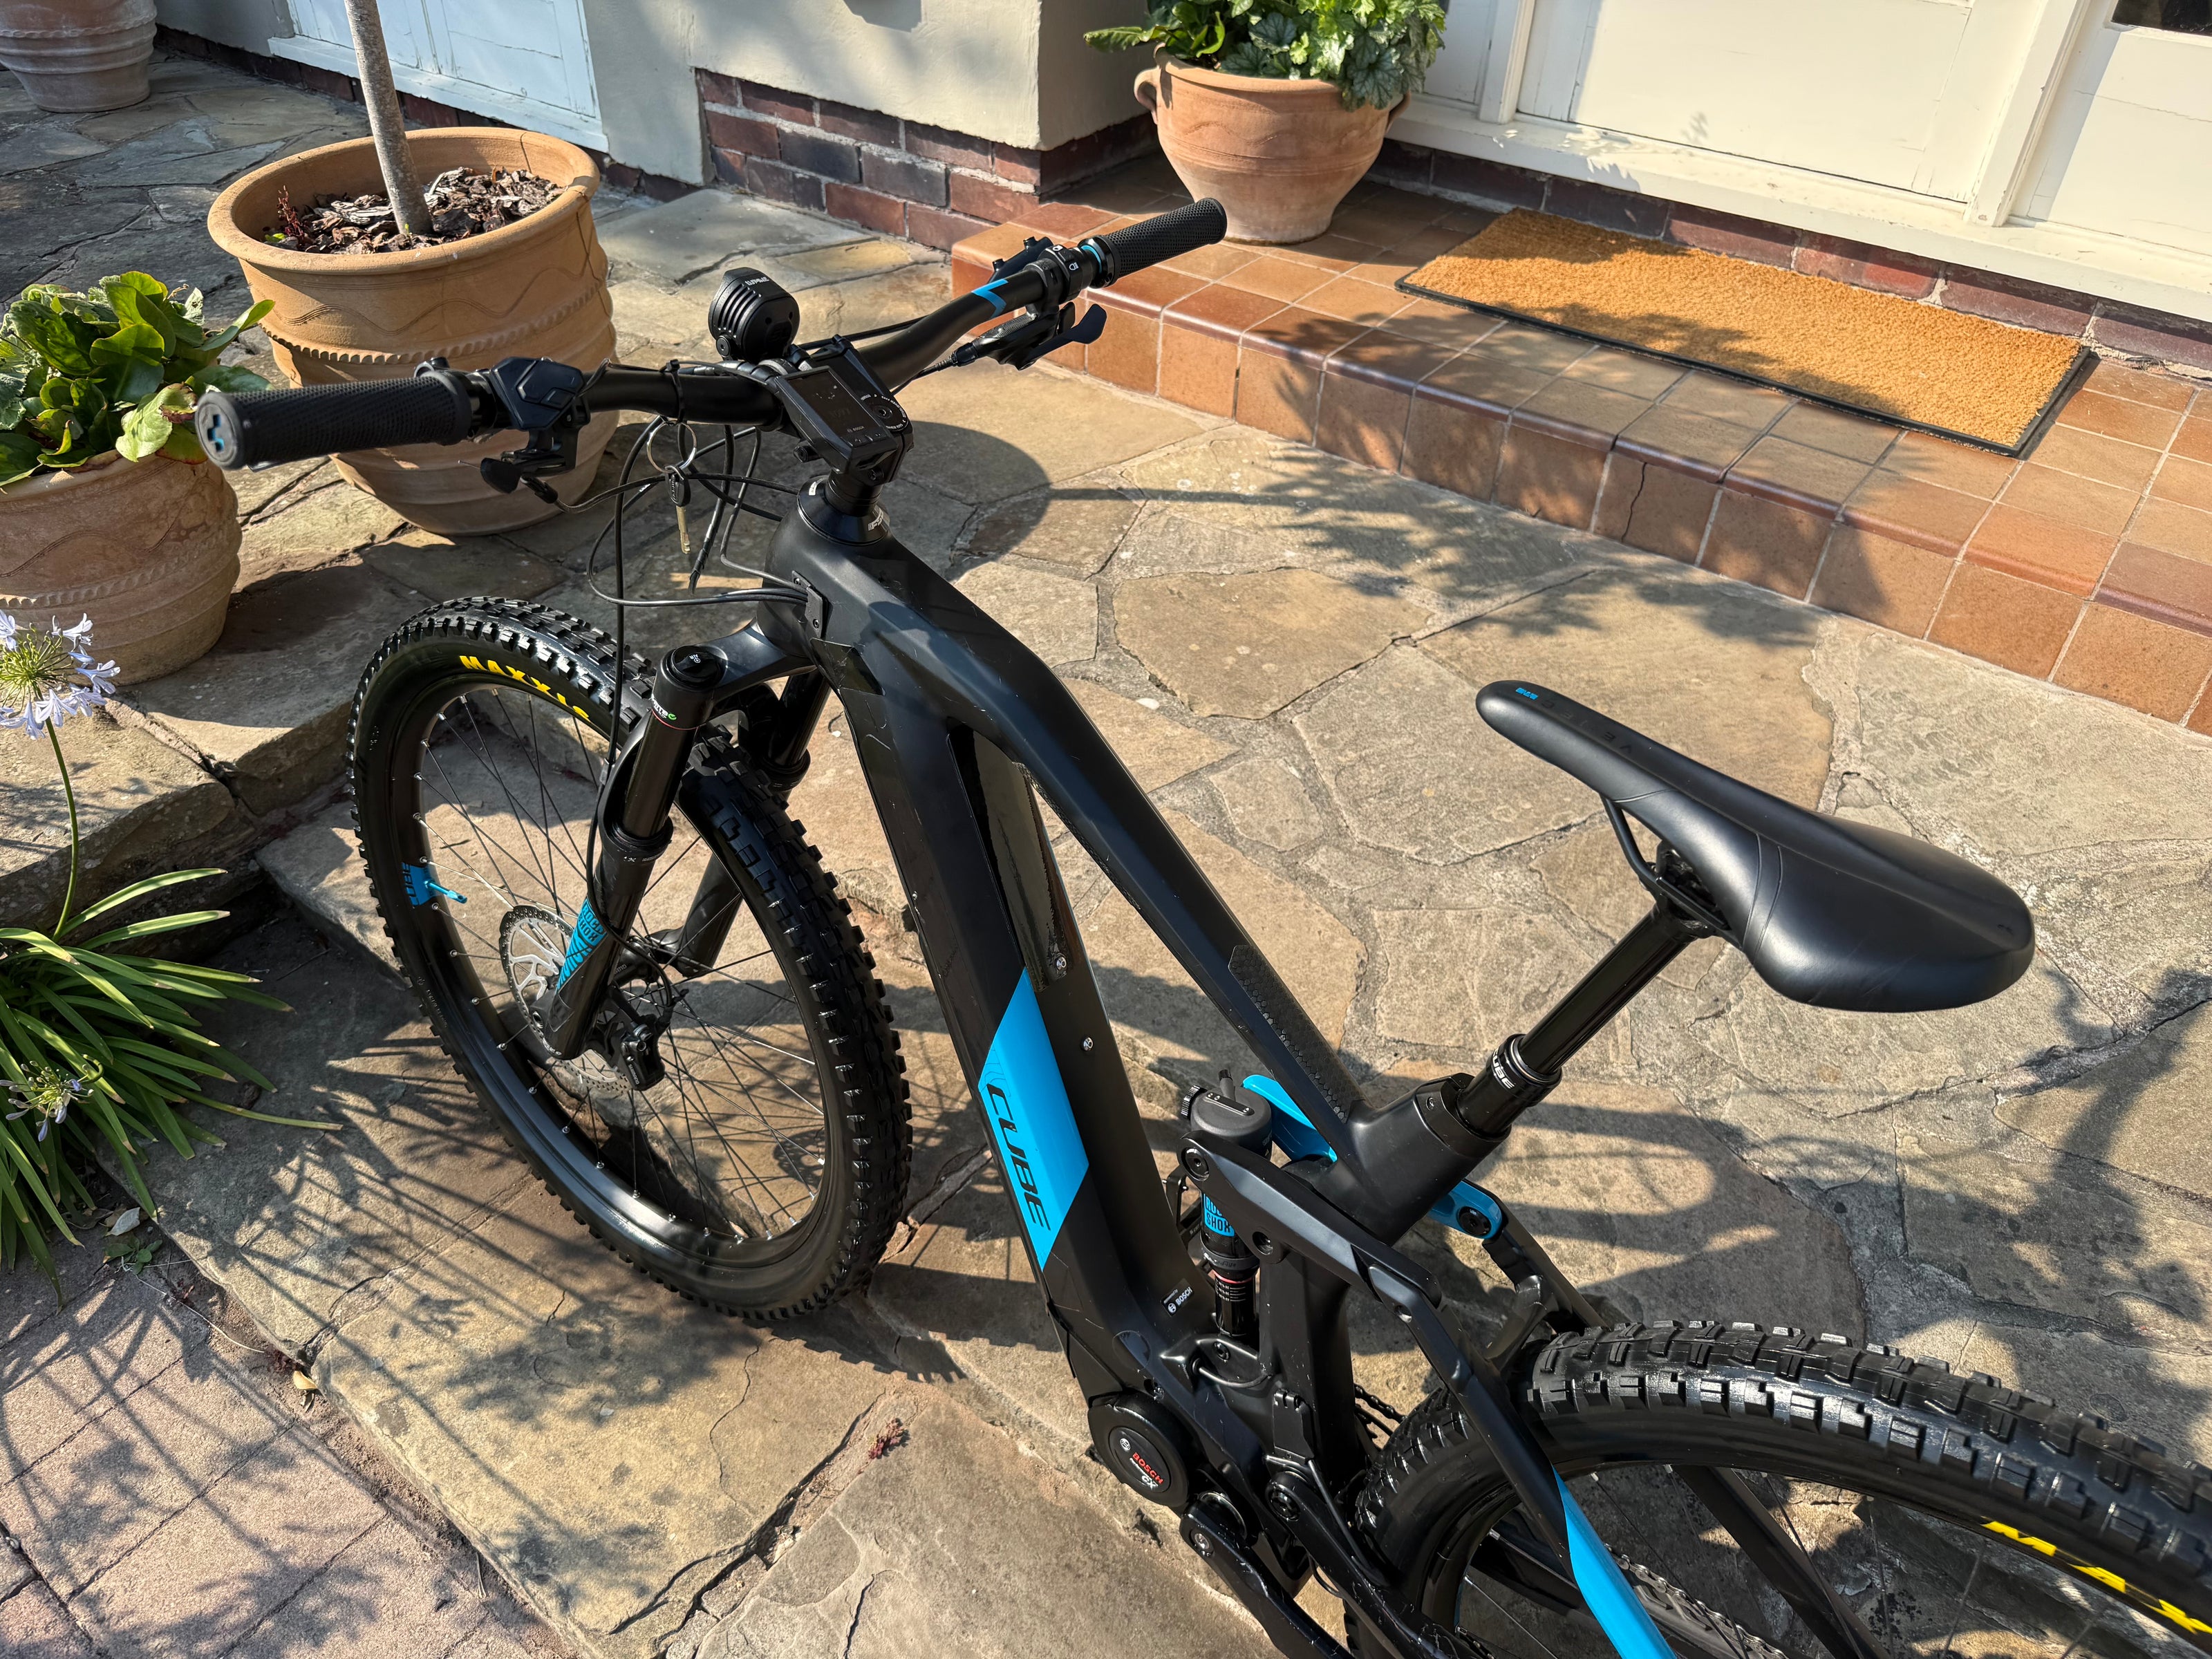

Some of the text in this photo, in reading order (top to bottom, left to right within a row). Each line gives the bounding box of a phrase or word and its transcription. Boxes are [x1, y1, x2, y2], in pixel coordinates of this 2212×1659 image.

[986, 1083, 1051, 1231] CUBE
[1206, 1212, 1231, 1233] SHOX
[1175, 1286, 1193, 1306] BOSCH
[1132, 1452, 1164, 1484] BOSCH
[1141, 1474, 1156, 1490] CX
